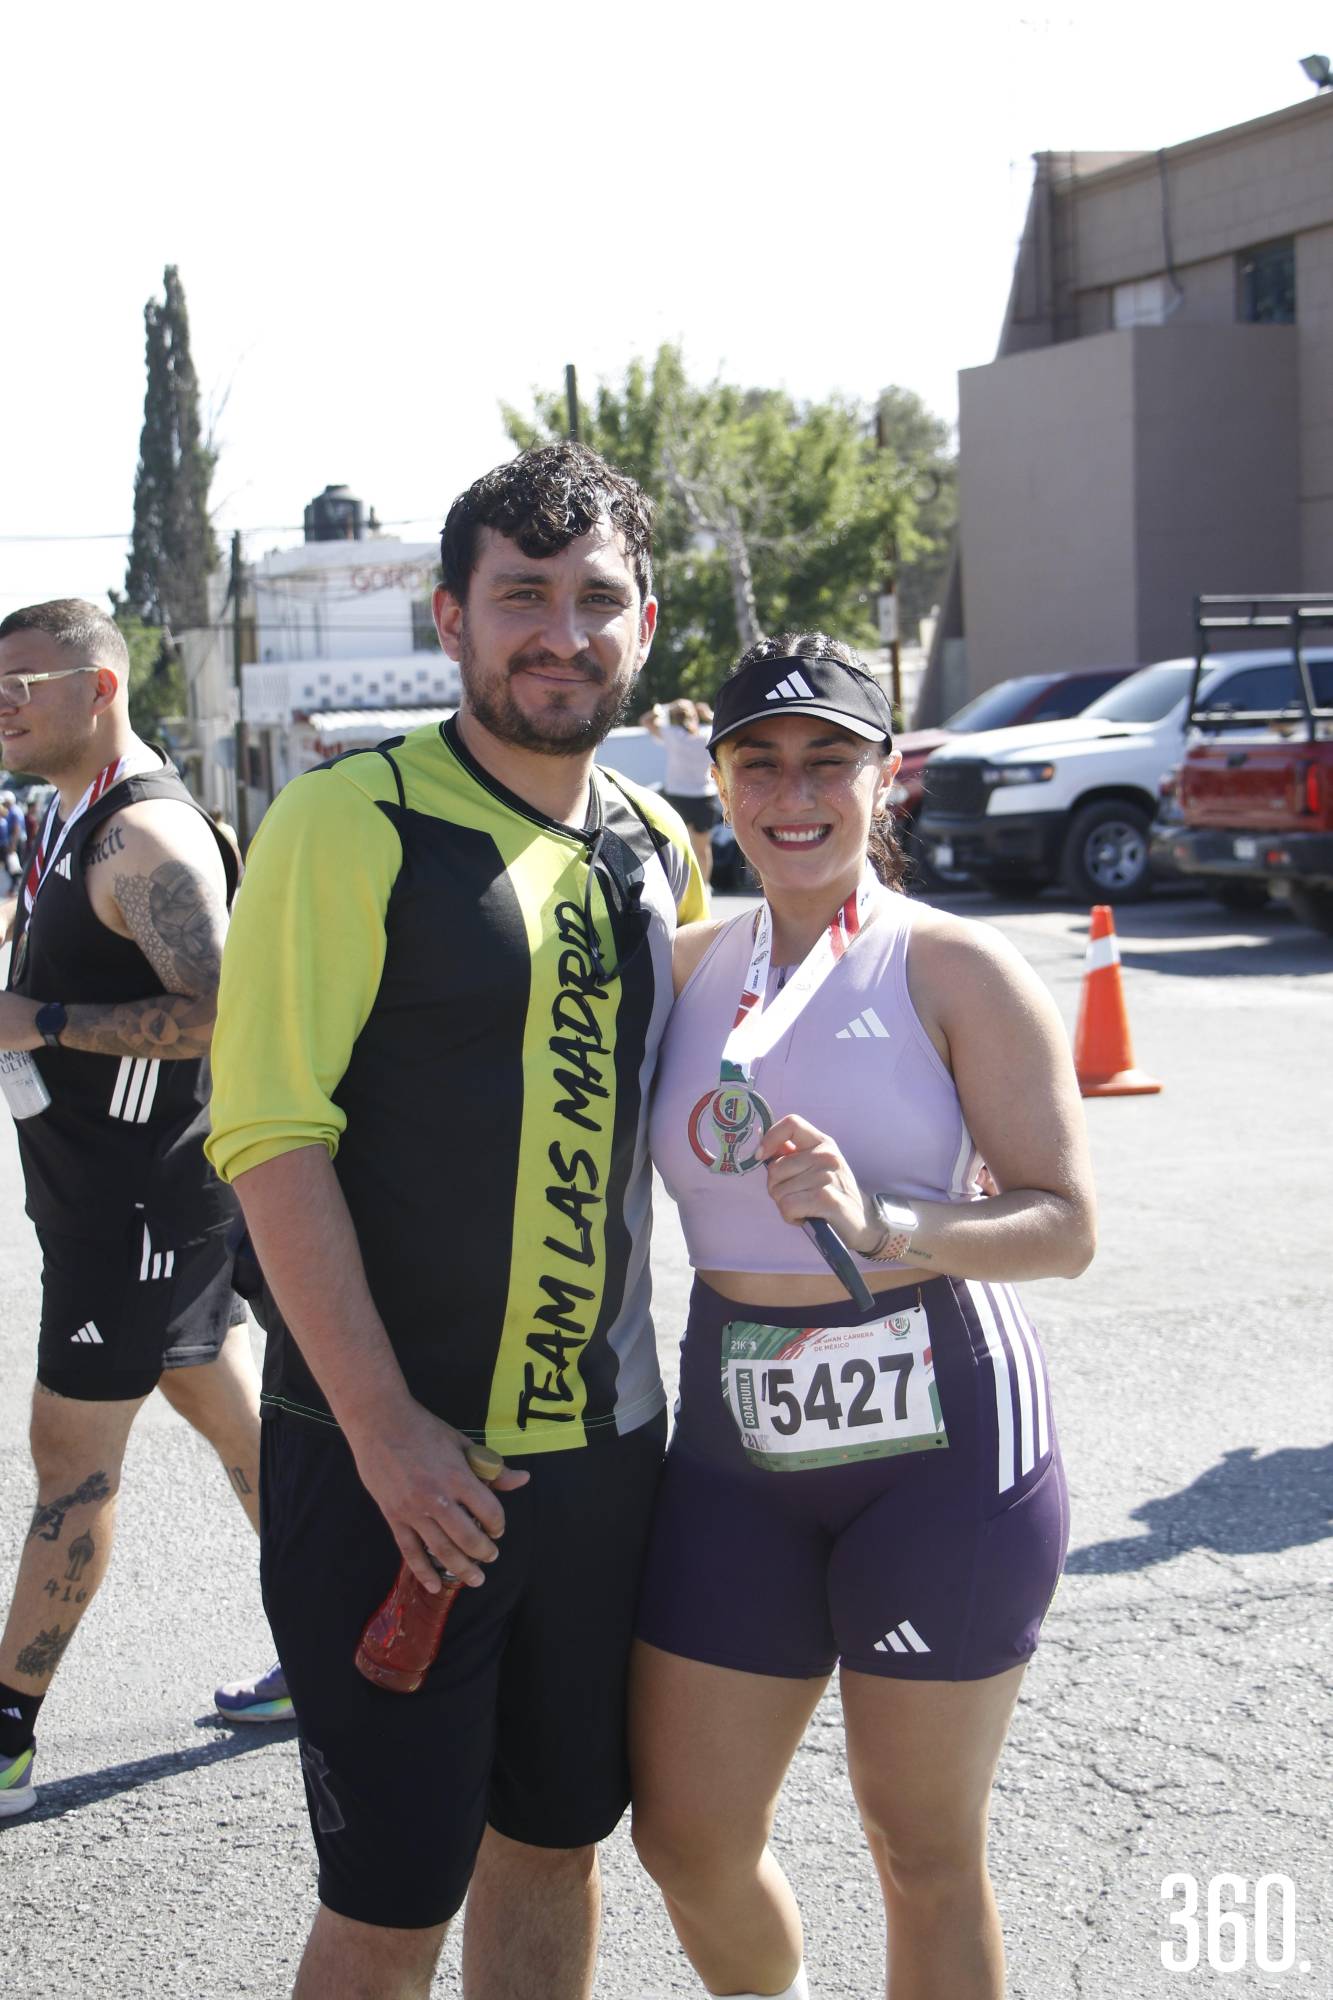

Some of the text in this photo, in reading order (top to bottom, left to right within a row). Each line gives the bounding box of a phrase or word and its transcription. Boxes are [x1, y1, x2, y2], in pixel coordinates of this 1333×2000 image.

[517, 901, 610, 1431] TEAM LAS MADRID
[740, 1372, 755, 1426] COAHUILA
[767, 1352, 915, 1436] 5427
